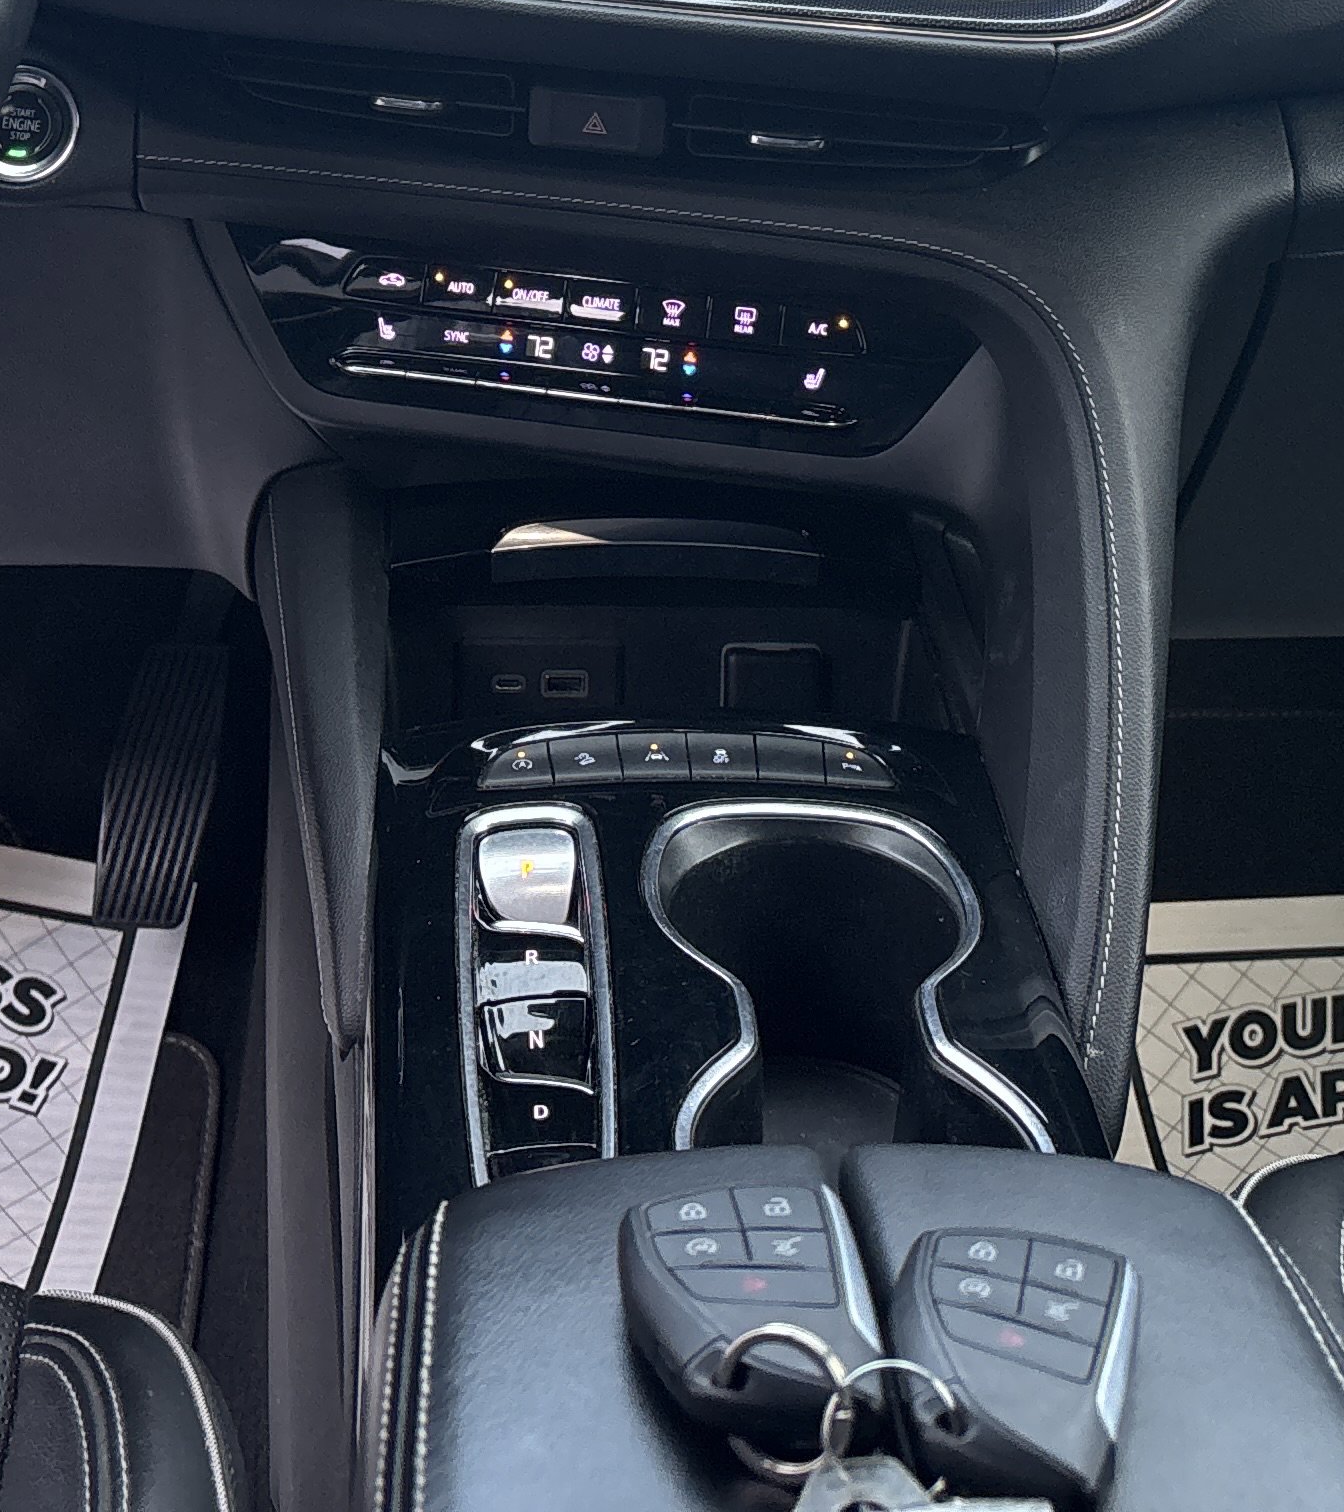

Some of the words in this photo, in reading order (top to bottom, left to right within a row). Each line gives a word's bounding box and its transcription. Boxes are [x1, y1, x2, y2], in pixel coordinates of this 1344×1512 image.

[10, 108, 36, 117] START
[2, 116, 41, 133] ENGINE
[9, 132, 31, 140] STOP
[447, 281, 474, 294] AUTO
[512, 289, 549, 302] ON/OFF
[581, 296, 621, 311] CLIMATE
[662, 317, 681, 327] MAX
[734, 324, 754, 334] REAR
[807, 322, 829, 336] A/C
[443, 330, 469, 344] SYNC
[527, 334, 554, 359] 72
[642, 347, 670, 371] 72
[524, 949, 539, 965] R
[529, 1029, 545, 1049] N
[533, 1104, 549, 1120] D
[1184, 1092, 1255, 1152] IS
